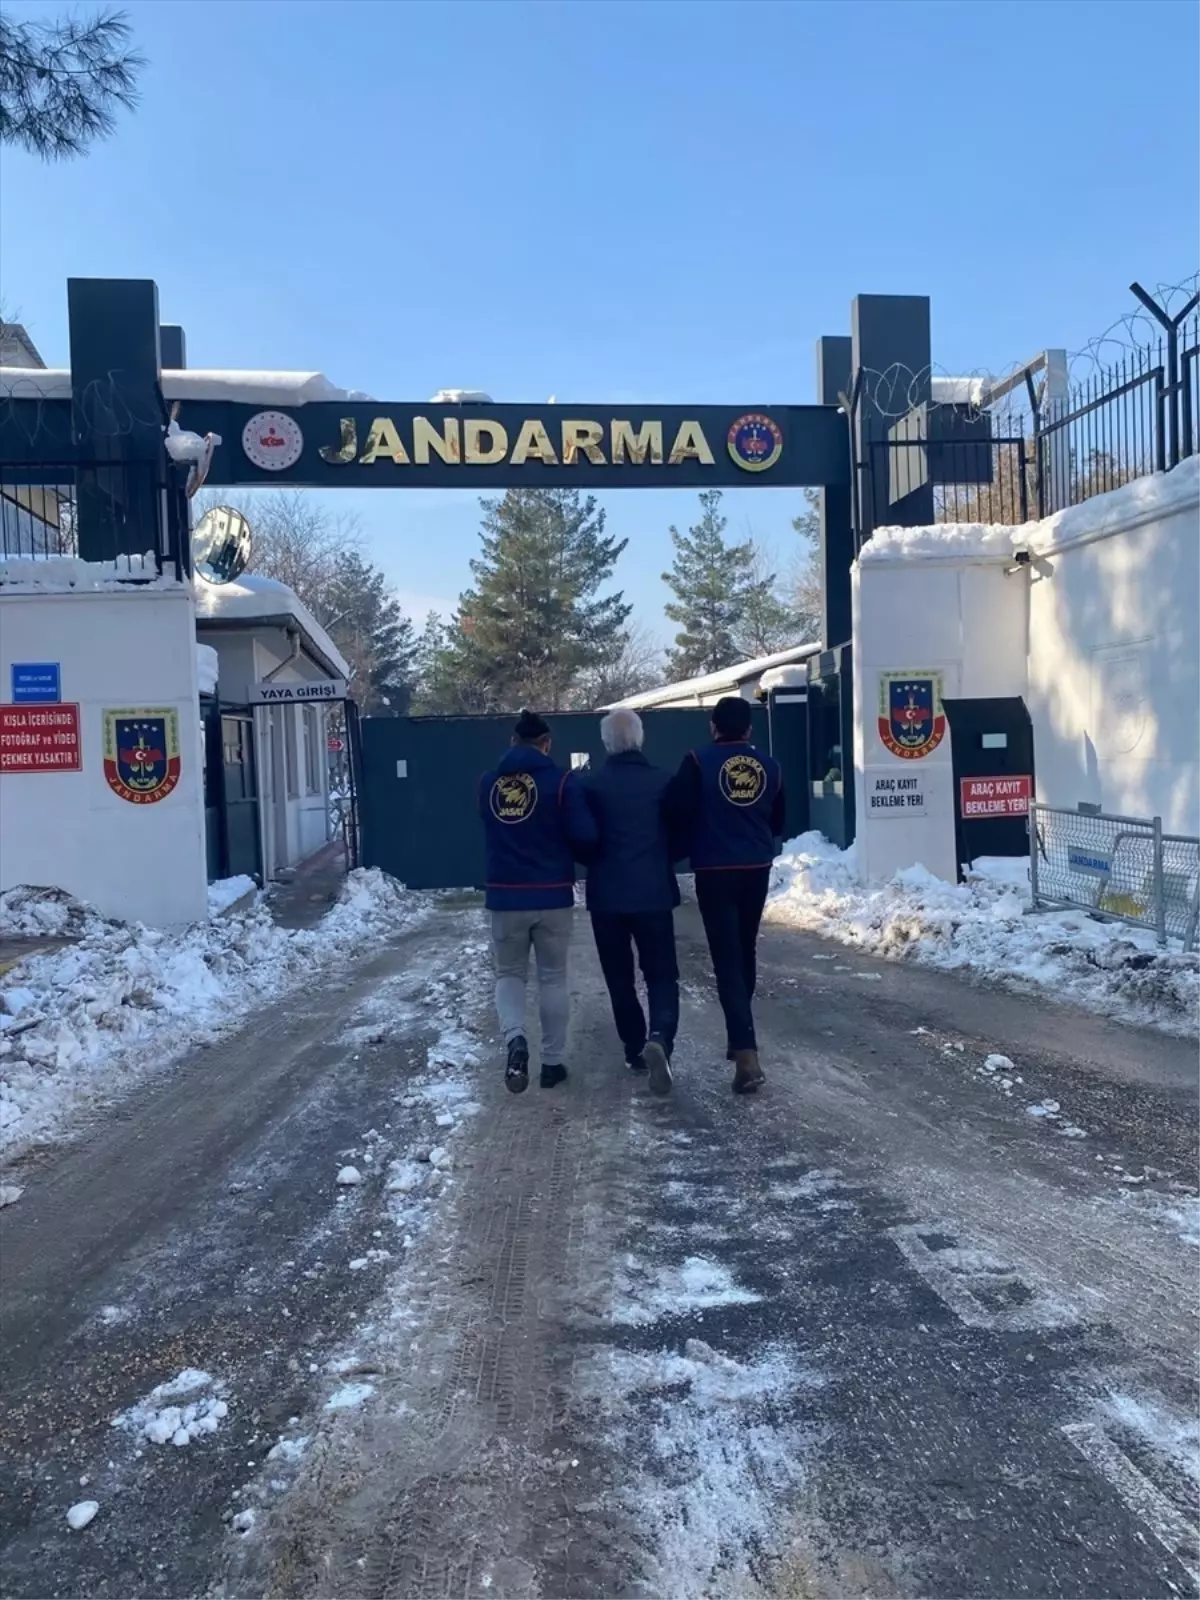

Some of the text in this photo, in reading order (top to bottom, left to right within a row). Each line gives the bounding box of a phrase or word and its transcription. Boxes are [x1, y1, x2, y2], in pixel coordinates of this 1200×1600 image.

[318, 416, 716, 465] JANDARMA
[261, 684, 336, 699] YAYA GİRİŞİ
[3, 711, 73, 728] KIŞLA İÇERİSİNDE
[0, 730, 76, 746] FOTOĞRAF ve VİDEO
[882, 733, 941, 757] JANDARMA
[1, 753, 33, 767] ÇEKMEK
[35, 751, 73, 764] YASAKTIR
[107, 775, 177, 802] JANDARMA
[875, 778, 918, 793] ARAÇ KAYIT
[970, 781, 1022, 797] ARAÇ KAYIT
[730, 790, 756, 798] JASAT
[871, 793, 924, 808] BEKLEME YERİ
[965, 796, 1028, 814] BEKLEME YERİ
